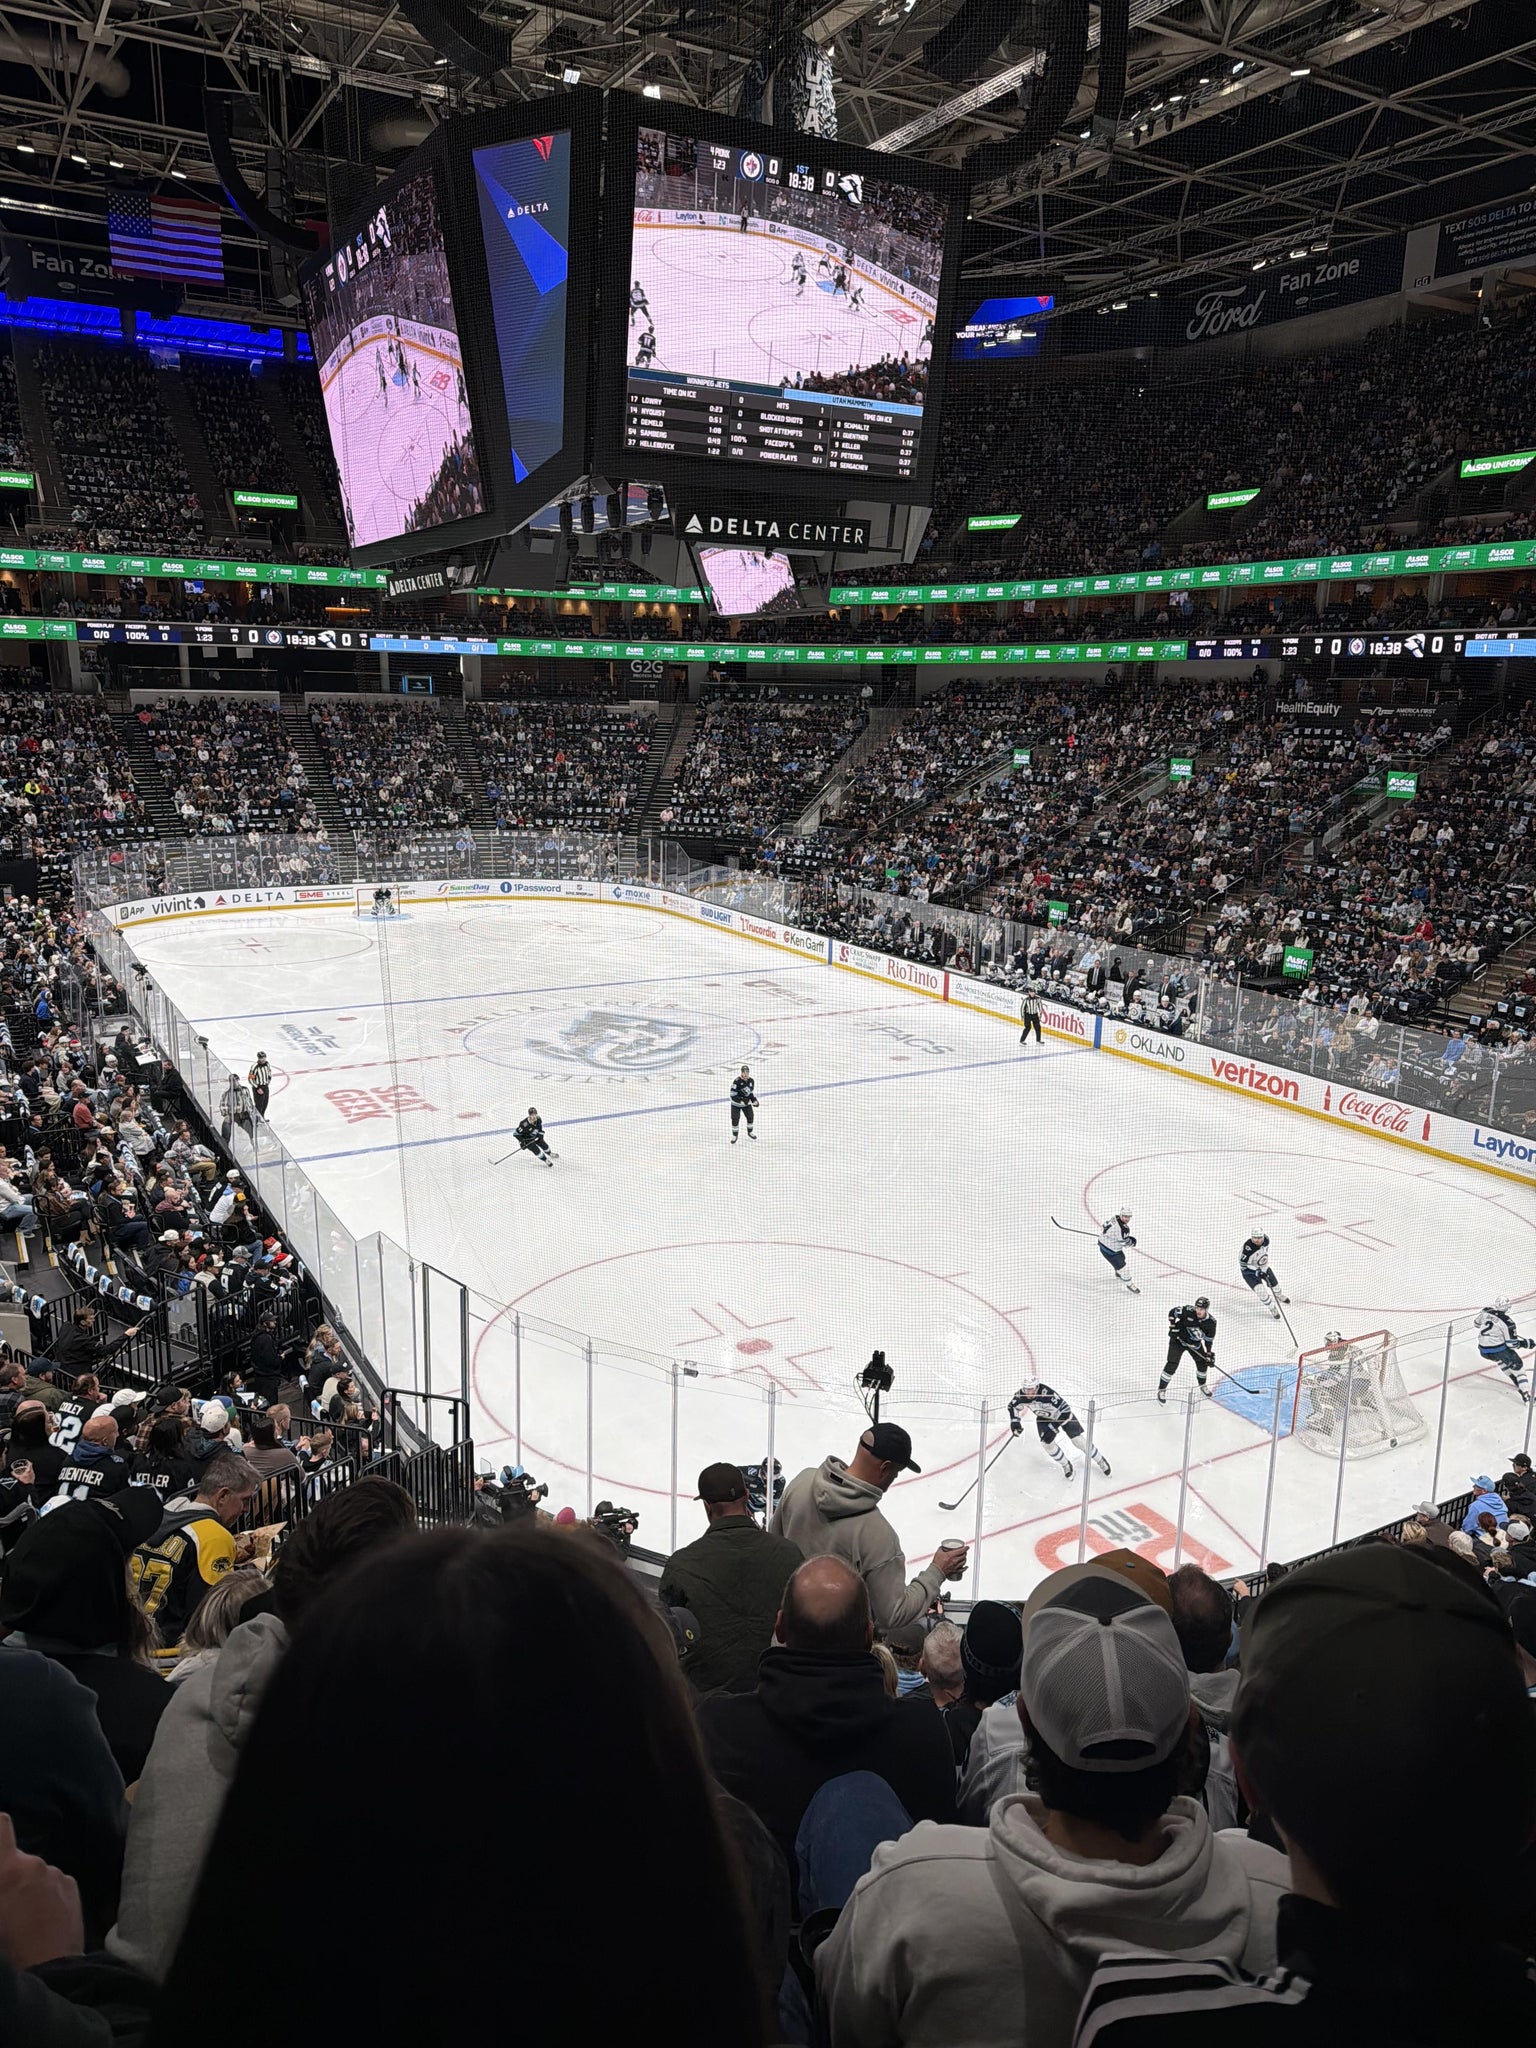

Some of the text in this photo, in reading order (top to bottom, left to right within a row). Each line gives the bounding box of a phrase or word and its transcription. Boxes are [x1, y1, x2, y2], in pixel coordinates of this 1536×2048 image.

[713, 158, 726, 170] 1:23
[768, 159, 778, 176] 0
[796, 164, 810, 174] 1ST
[788, 172, 815, 192] 18:38
[825, 171, 835, 188] 0
[517, 202, 550, 216] DELTA
[1444, 201, 1532, 235] TEXT SOS DELTA TO
[31, 250, 74, 274] Fan
[1279, 258, 1360, 294] Fan Zone
[1414, 276, 1431, 288] GG
[1186, 286, 1266, 341] Ford
[686, 378, 730, 390] WINNIPEG JETS
[663, 387, 697, 399] TIME ON ICE
[630, 406, 638, 414] 14
[642, 397, 662, 406] LOWRY
[709, 405, 724, 414] 0:23
[776, 402, 790, 410] HITS
[846, 398, 874, 408] MAMMOTH
[632, 417, 638, 425] 2
[738, 410, 804, 425] 0 BLOCKED SHOTS
[628, 428, 637, 436] 54
[758, 426, 774, 434] SHOT
[774, 427, 804, 438] ATTEMPTS
[628, 438, 637, 446] 37
[708, 447, 721, 456] 1:22
[730, 434, 748, 444] 100%
[764, 439, 788, 448] FACEOFF
[842, 442, 860, 451] KELLER
[732, 448, 822, 464] 0/0 POWER PLAYS 0/1
[1462, 460, 1492, 474] ALSCO
[236, 494, 296, 506] ALSCO UNIFORMS
[1209, 496, 1229, 507] ALSCO
[710, 516, 865, 544] DELTA CENTER
[969, 518, 990, 528] ALSCO
[1406, 555, 1430, 563] ALSCO
[1488, 548, 1515, 557] ALSCO
[82, 558, 106, 566] ALSCO
[1330, 561, 1352, 569] ALSCO
[395, 572, 444, 595] DELTA CENTER
[125, 631, 150, 640] 100%
[196, 634, 213, 642] 1:23
[248, 630, 258, 643] 0
[286, 634, 316, 646] 18:38
[341, 634, 352, 646] 0
[1224, 648, 1242, 656] 100%
[1282, 646, 1298, 656] 1:23
[1331, 638, 1342, 654] 0
[1369, 642, 1402, 655] 18:38
[1431, 636, 1444, 654] 0
[630, 660, 664, 674] G2G
[1276, 701, 1340, 718] HealthEquity
[450, 884, 490, 892] SameDay
[514, 884, 562, 892] 1Password
[625, 889, 650, 900] moxie
[232, 891, 285, 904] DELTA
[700, 906, 732, 924] BUD LIGHT
[743, 916, 777, 939] Trucordia
[790, 932, 825, 954] Ken Garff
[887, 958, 908, 980] Rio
[907, 964, 938, 990] Tinto
[1040, 1003, 1085, 1036] Smith's
[1130, 1034, 1186, 1062] OKLAND
[1210, 1056, 1300, 1102] verizon
[370, 1084, 440, 1113] SEAT
[324, 1088, 393, 1124] GEEK
[1338, 1091, 1414, 1134] Coca-Cola
[1480, 1320, 1494, 1336] 2
[58, 1402, 84, 1416] COOLEY
[58, 1466, 104, 1486] GUENTHER
[136, 1472, 170, 1488] KELER
